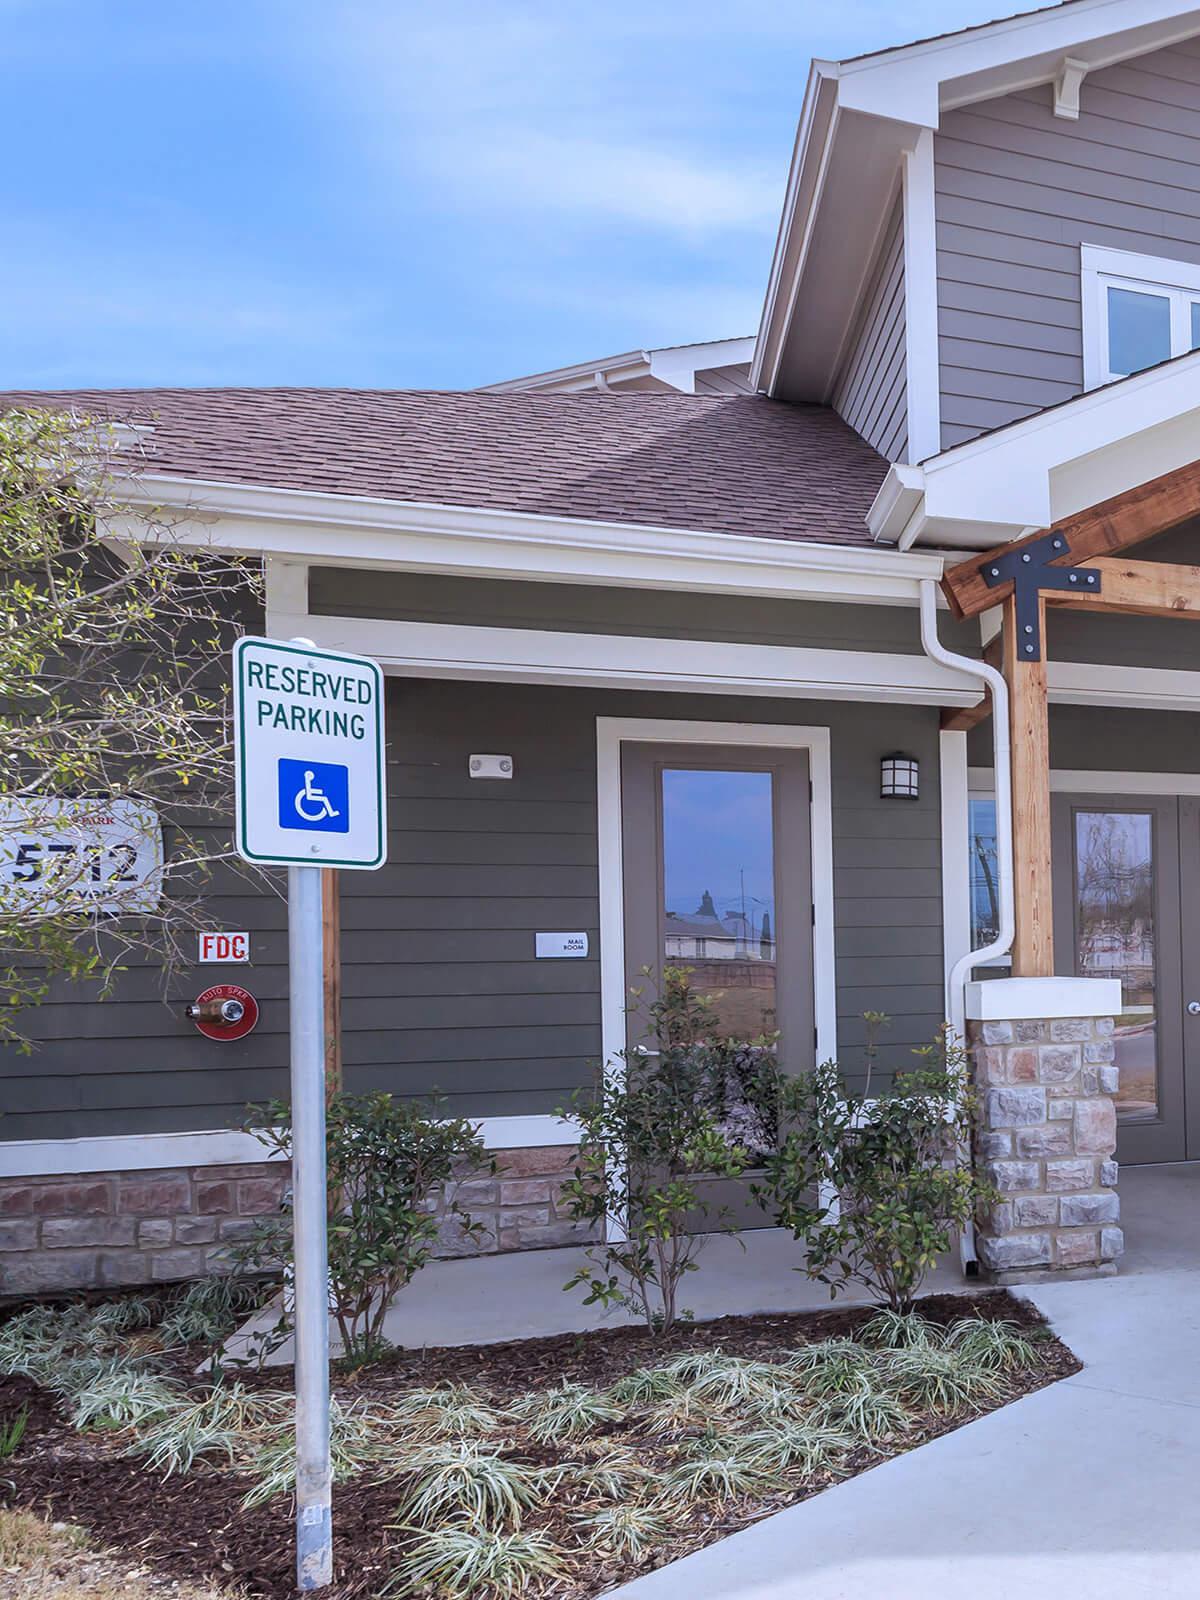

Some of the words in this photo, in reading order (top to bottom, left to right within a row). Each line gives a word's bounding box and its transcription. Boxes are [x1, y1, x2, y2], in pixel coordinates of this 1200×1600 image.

[247, 660, 372, 705] RESERVED
[257, 700, 365, 740] PARKING
[12, 844, 139, 882] 5712
[203, 935, 246, 960] FDC
[203, 987, 223, 1003] AUTO
